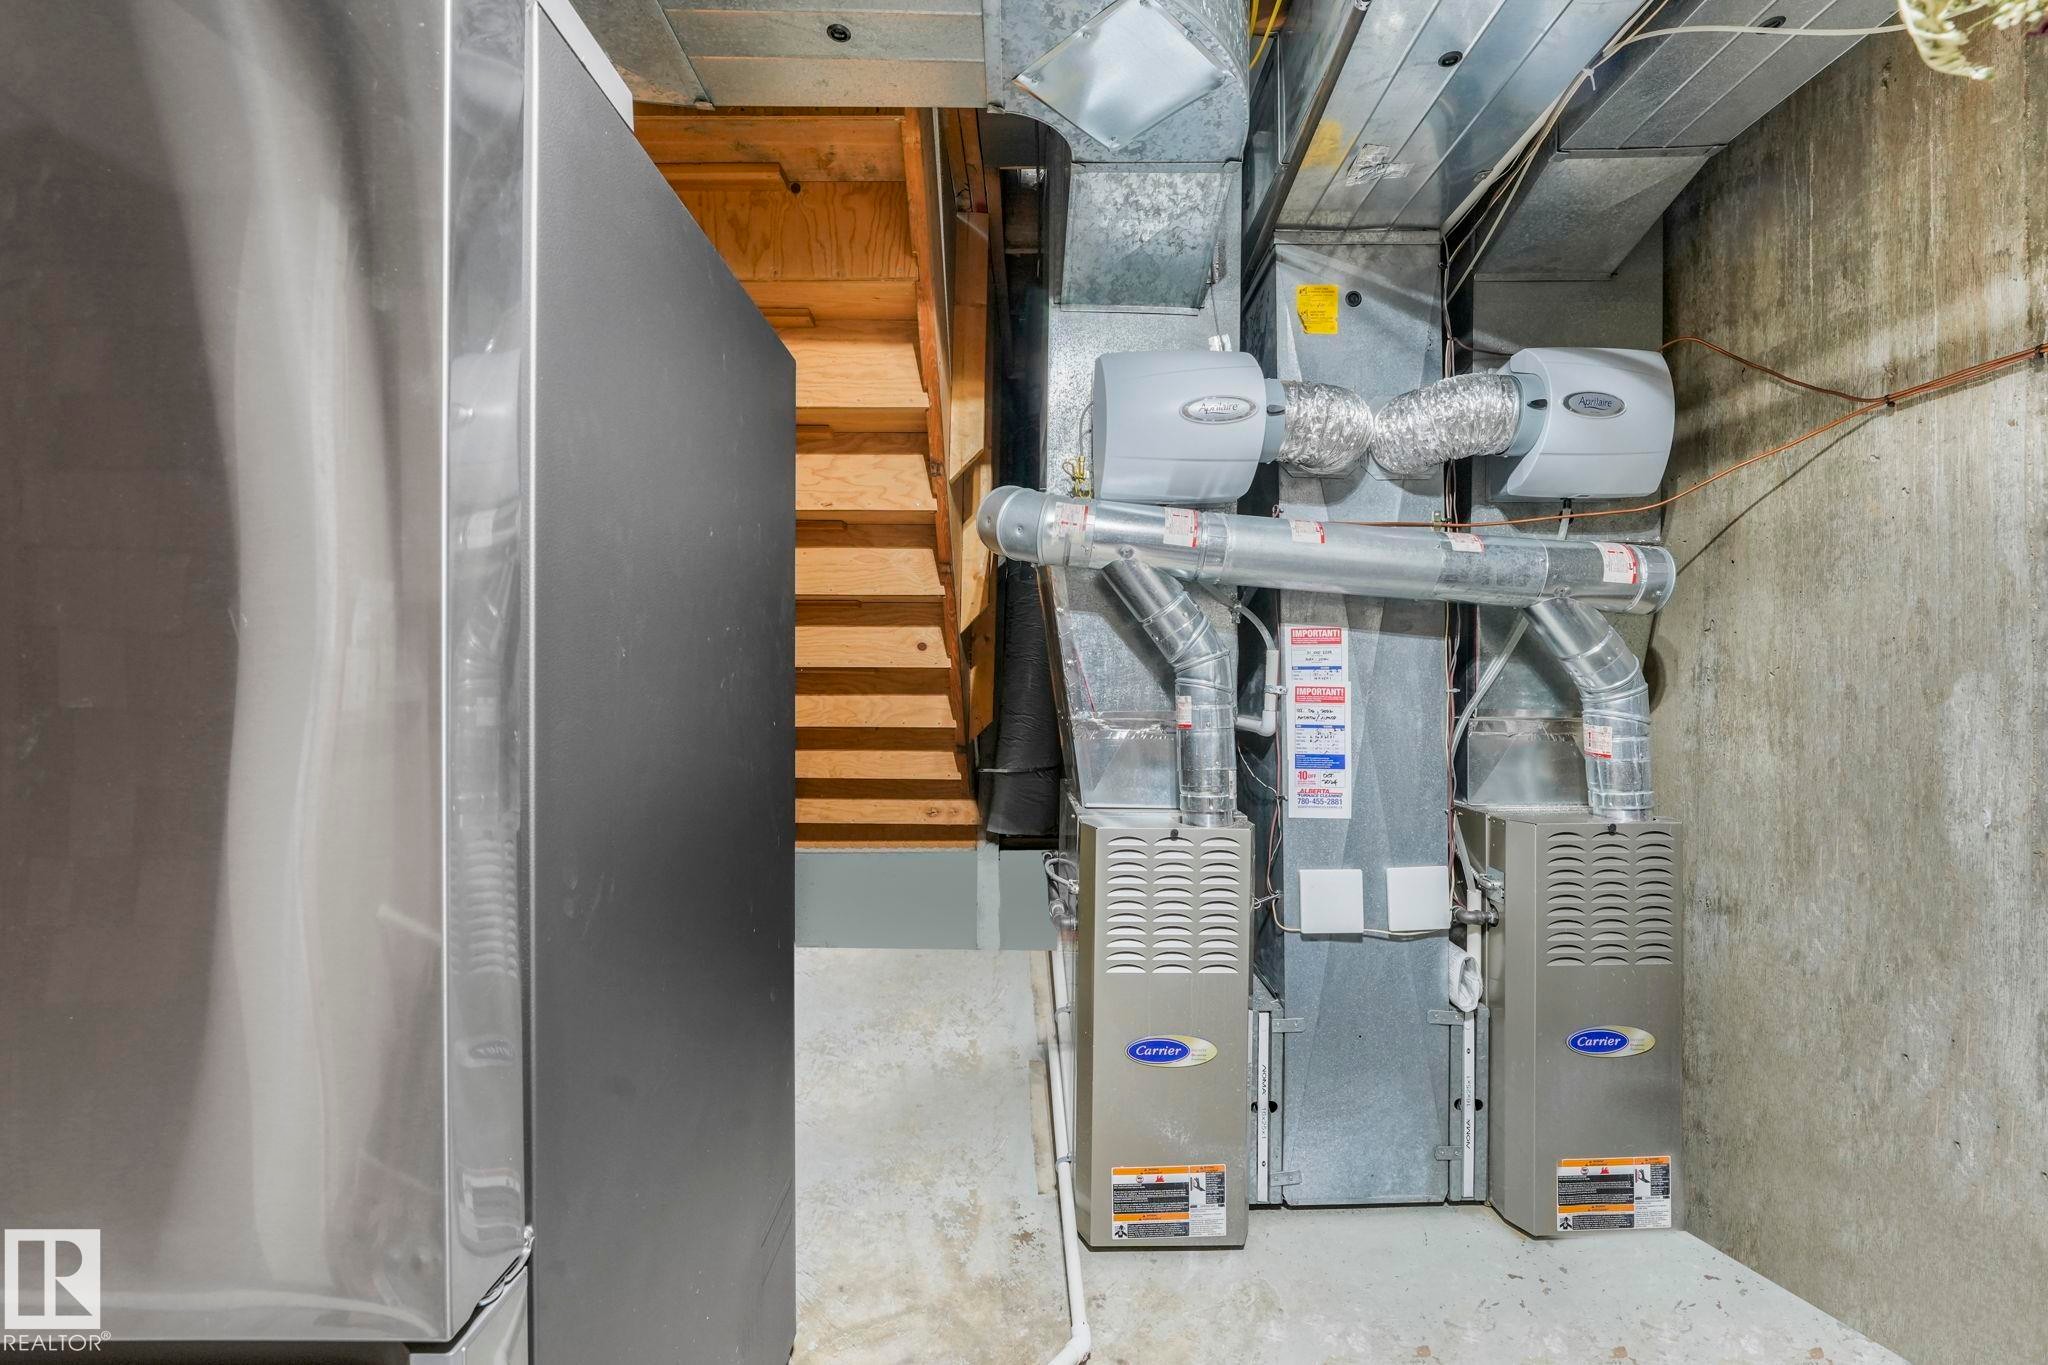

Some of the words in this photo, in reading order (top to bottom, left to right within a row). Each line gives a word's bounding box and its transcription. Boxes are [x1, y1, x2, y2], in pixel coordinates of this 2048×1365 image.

[1578, 396, 1613, 408] Aprilaire
[1292, 629, 1340, 638] IMPORTANT!
[1296, 687, 1344, 696] IMPORTANT!
[1577, 1037, 1621, 1047] Carrier
[1136, 1045, 1181, 1056] Carrier
